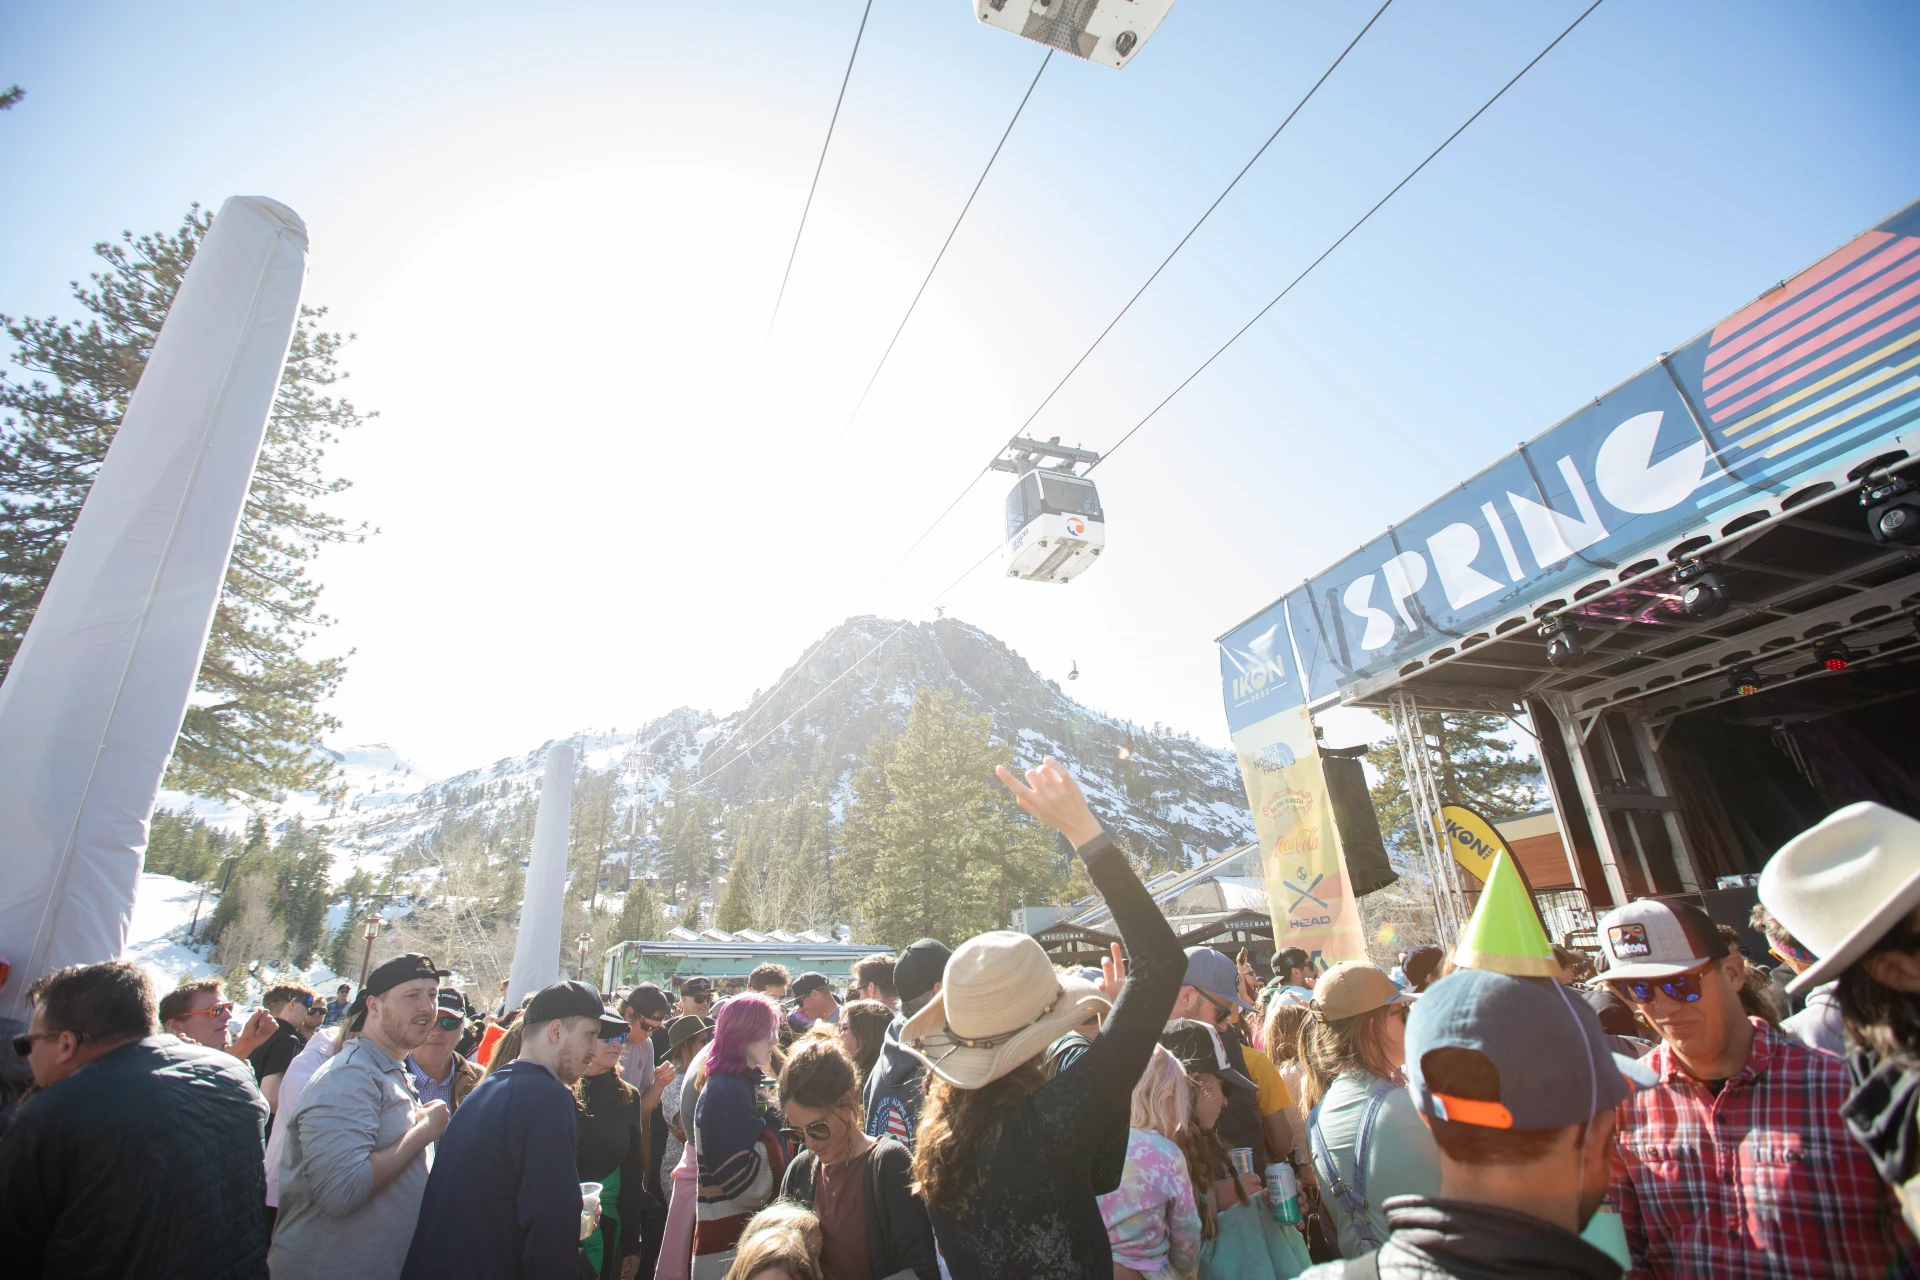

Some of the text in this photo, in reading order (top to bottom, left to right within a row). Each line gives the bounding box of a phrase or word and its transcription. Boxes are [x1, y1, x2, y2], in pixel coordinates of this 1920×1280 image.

[1343, 411, 1706, 650] SPRING
[1233, 655, 1285, 700] IKON
[1251, 688, 1270, 703] PASS
[1262, 743, 1278, 756] THE
[1254, 751, 1280, 769] NORTH
[1263, 763, 1282, 774] FACE
[1482, 848, 1494, 860] PASS
[1290, 916, 1331, 928] HEAD
[870, 1115, 879, 1136] UAW
